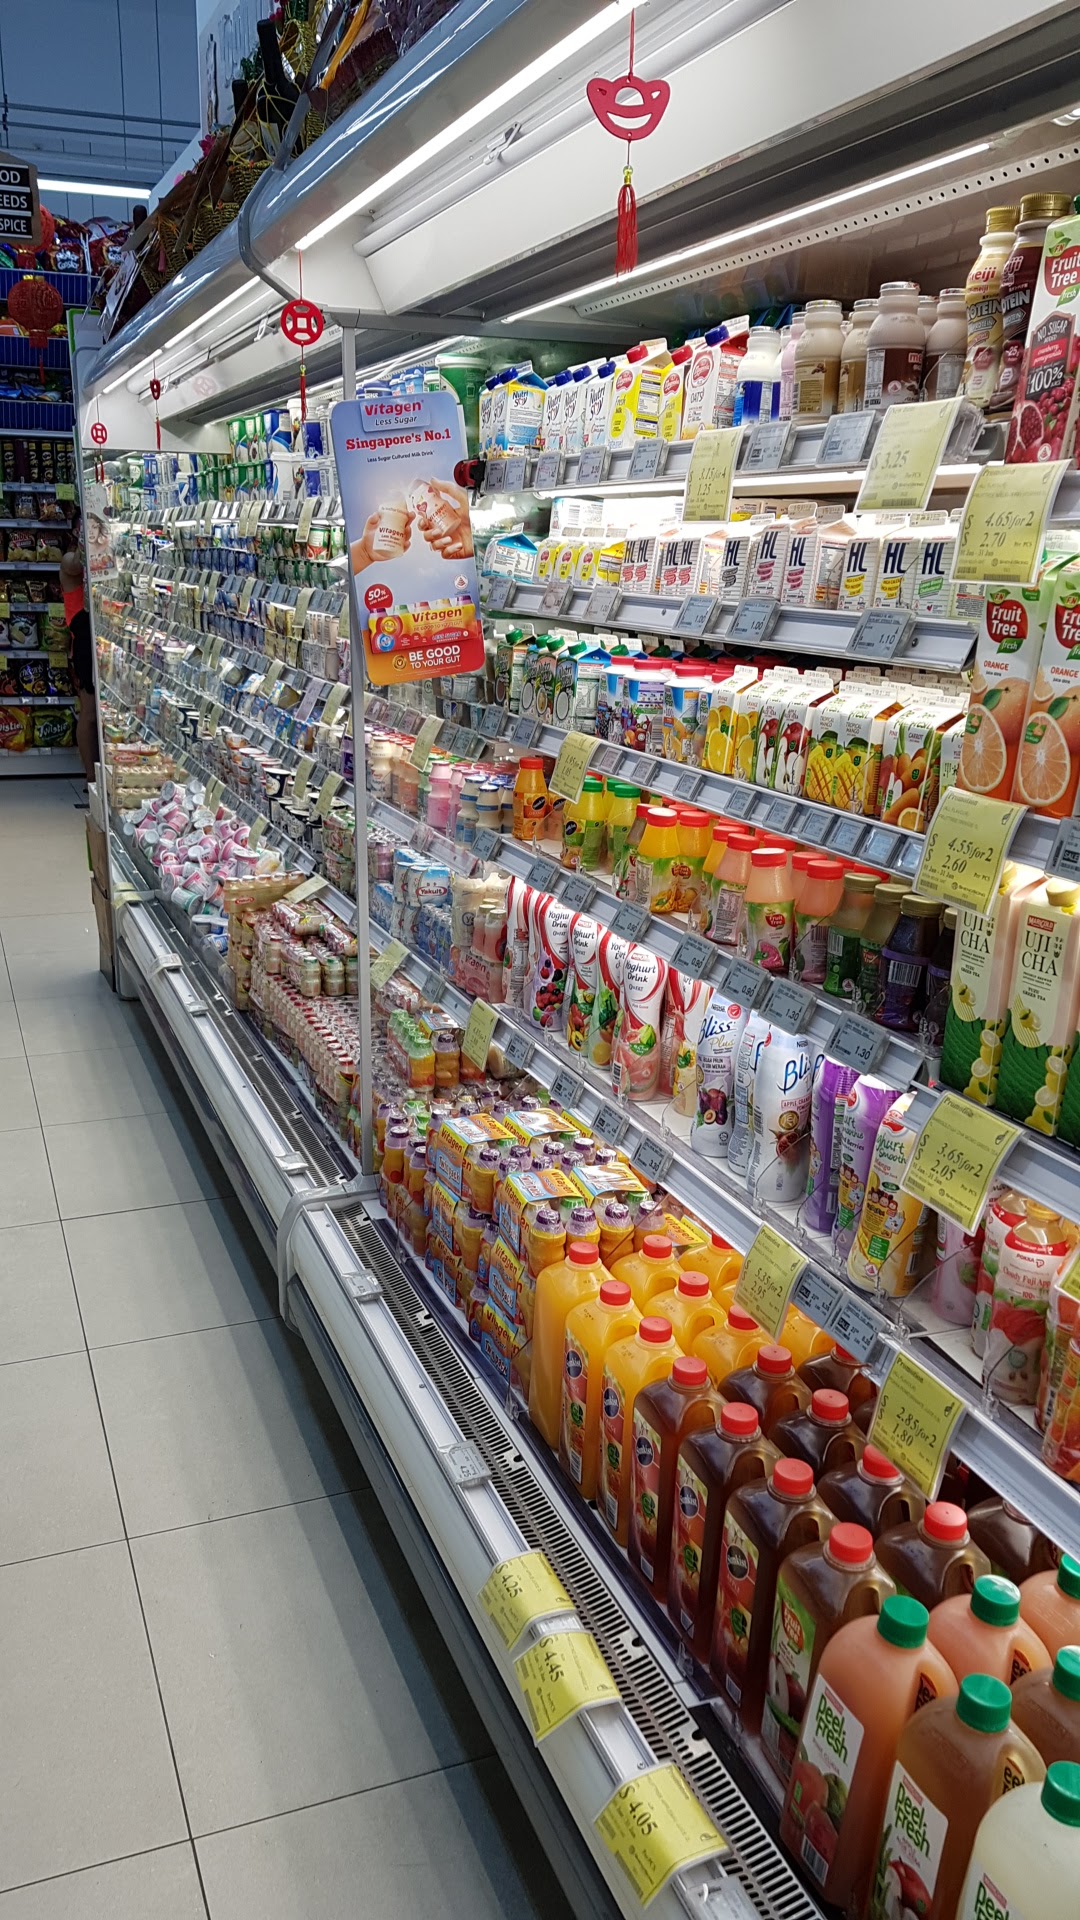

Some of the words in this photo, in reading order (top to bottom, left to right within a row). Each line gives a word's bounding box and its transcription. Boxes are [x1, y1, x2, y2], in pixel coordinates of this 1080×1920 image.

[1051, 270, 1078, 288] Tree
[1048, 320, 1068, 335] SUGAR
[1031, 365, 1063, 394] 100%
[364, 400, 421, 416] Vitagen
[375, 418, 392, 426] Less
[394, 416, 417, 425] Sugar
[346, 433, 422, 451] Singapore's
[424, 428, 452, 441] No.1
[881, 450, 910, 470] 3.25
[1025, 510, 1035, 527] 2
[379, 527, 404, 538] Vitagen
[980, 532, 1007, 548] 2.70
[624, 541, 636, 563] HL
[637, 540, 650, 563] HL
[665, 542, 678, 566] HL
[681, 541, 694, 565] HL
[724, 540, 741, 566] HL
[760, 531, 778, 559] HL
[789, 537, 807, 566] HL
[846, 542, 868, 572] HL
[883, 542, 907, 574] HL
[921, 542, 945, 574] HL
[412, 607, 463, 623] Vitagen
[992, 606, 1022, 623] Fruit
[751, 621, 763, 630] 1.00
[992, 620, 1018, 637] Tree
[879, 634, 896, 644] 1.10
[1001, 638, 1018, 651] fresh
[409, 651, 424, 662] BE
[426, 645, 461, 659] GOOD
[411, 661, 421, 669] TO
[423, 658, 444, 668] YOUR
[445, 655, 461, 664] GUT
[983, 660, 1009, 672] ORANGE
[1050, 667, 1079, 678] ORANGE
[908, 732, 924, 740] CARROT
[948, 837, 973, 855] 4.55
[985, 847, 994, 862] 2
[1063, 850, 1079, 861] SALE
[942, 855, 968, 874] 2.60
[420, 887, 443, 896] Yakult
[963, 911, 984, 932] UJI
[960, 930, 990, 954] CHA
[1025, 930, 1052, 953] UJI
[625, 960, 656, 974] Yoghurt
[961, 967, 972, 975] GREEN
[1021, 951, 1058, 977] CHA
[627, 972, 648, 983] Drink
[742, 985, 755, 997] 0.90
[1022, 990, 1036, 998] GREEN
[785, 1008, 800, 1021] 1.30
[708, 1035, 735, 1051] Plus
[854, 1045, 871, 1060] 1.30
[440, 1128, 463, 1153] Vitagen
[937, 1142, 963, 1165] 3.65
[974, 1163, 984, 1178] 2
[930, 1159, 957, 1181] 2.05
[494, 1244, 518, 1275] Vitagen
[1016, 1253, 1035, 1263] POKKA
[755, 1267, 771, 1286] 5.35
[777, 1285, 783, 1297] 2
[1003, 1265, 1020, 1282] Cloudy
[1023, 1275, 1037, 1286] Fuji
[750, 1281, 767, 1299] 2.95
[892, 1423, 914, 1447] 1.80
[896, 1406, 919, 1431] 2.85
[929, 1434, 937, 1449] 2
[728, 1555, 748, 1569] Sunkist
[501, 1574, 523, 1598] 4.25
[544, 1652, 565, 1683] 4.45
[628, 1801, 659, 1836] 4.05
